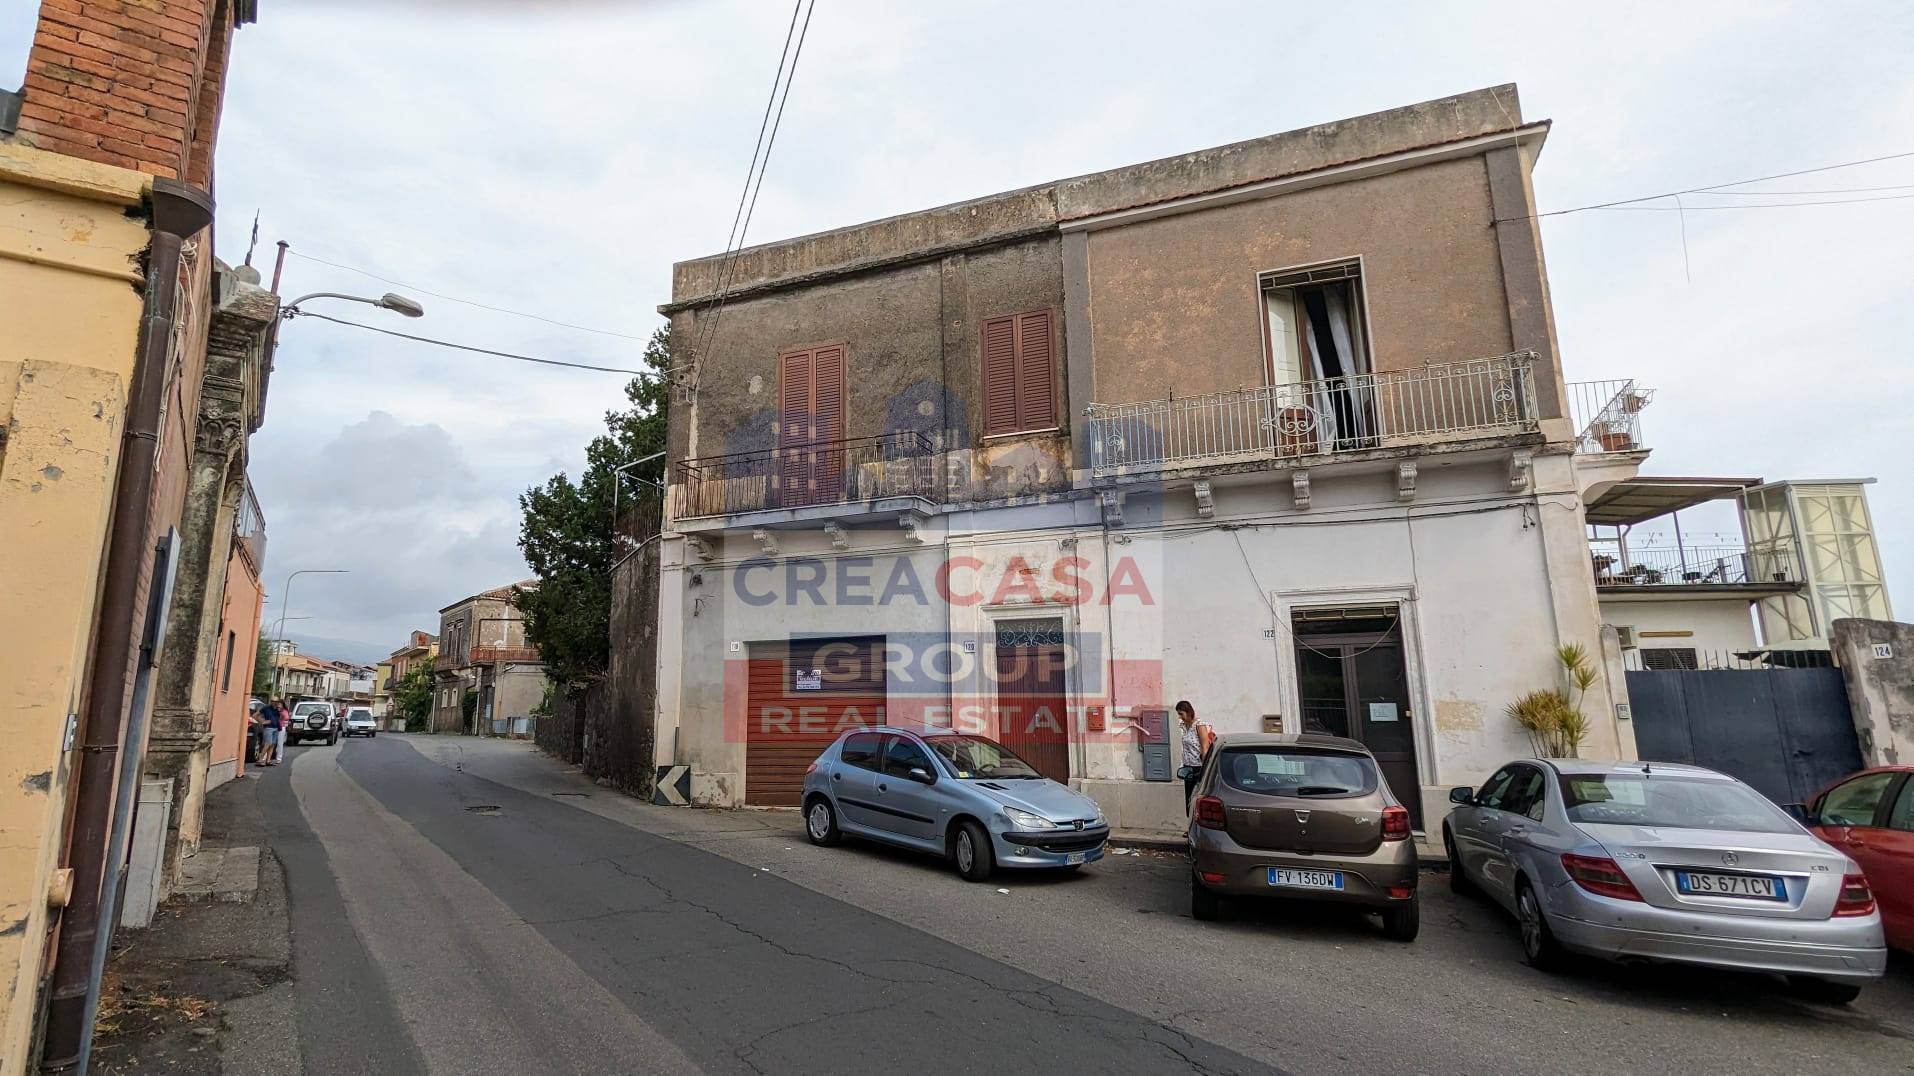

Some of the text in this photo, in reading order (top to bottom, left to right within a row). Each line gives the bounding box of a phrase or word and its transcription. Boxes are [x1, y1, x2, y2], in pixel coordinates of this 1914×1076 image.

[1875, 646, 1890, 656] 124
[1277, 870, 1334, 887] FV 136DW
[1690, 874, 1771, 895] DS 671CV
